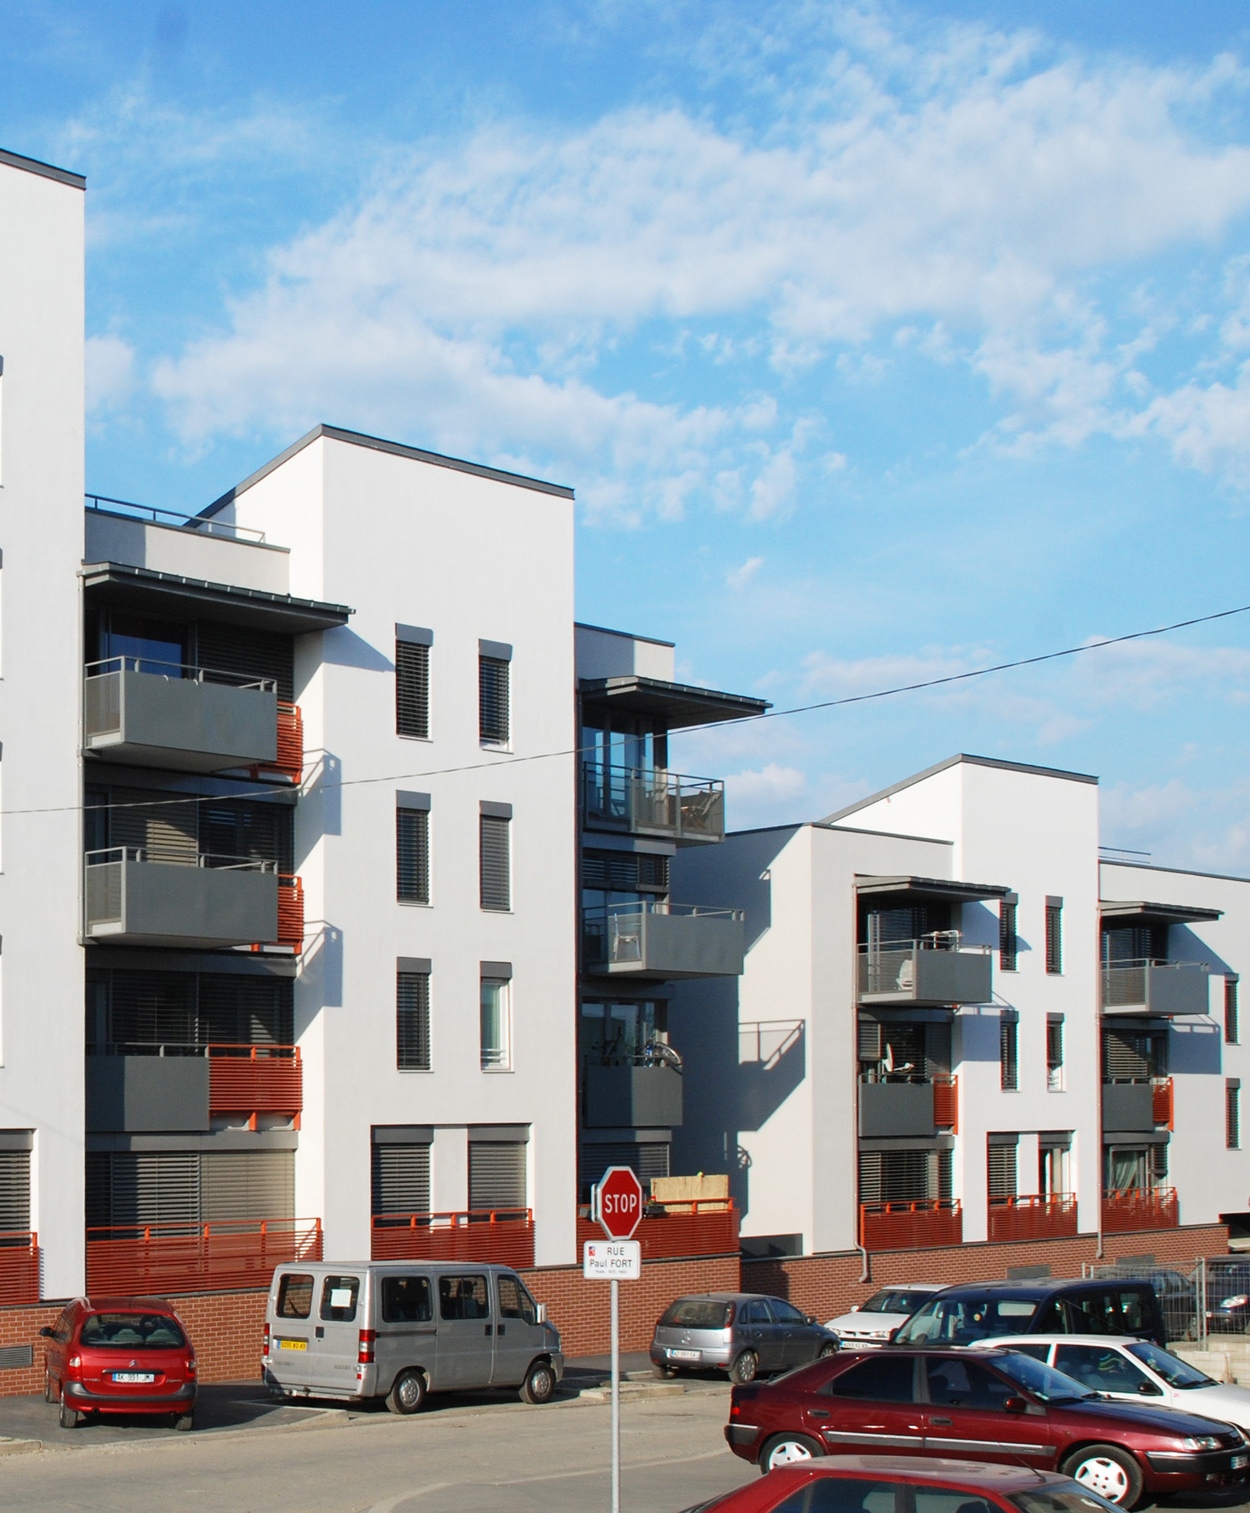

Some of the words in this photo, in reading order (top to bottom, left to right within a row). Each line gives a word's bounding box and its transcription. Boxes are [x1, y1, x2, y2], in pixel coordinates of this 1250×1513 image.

[605, 1194, 637, 1213] STOP
[607, 1247, 625, 1255] RUE
[590, 1259, 607, 1268] Paul
[611, 1259, 632, 1268] FORT
